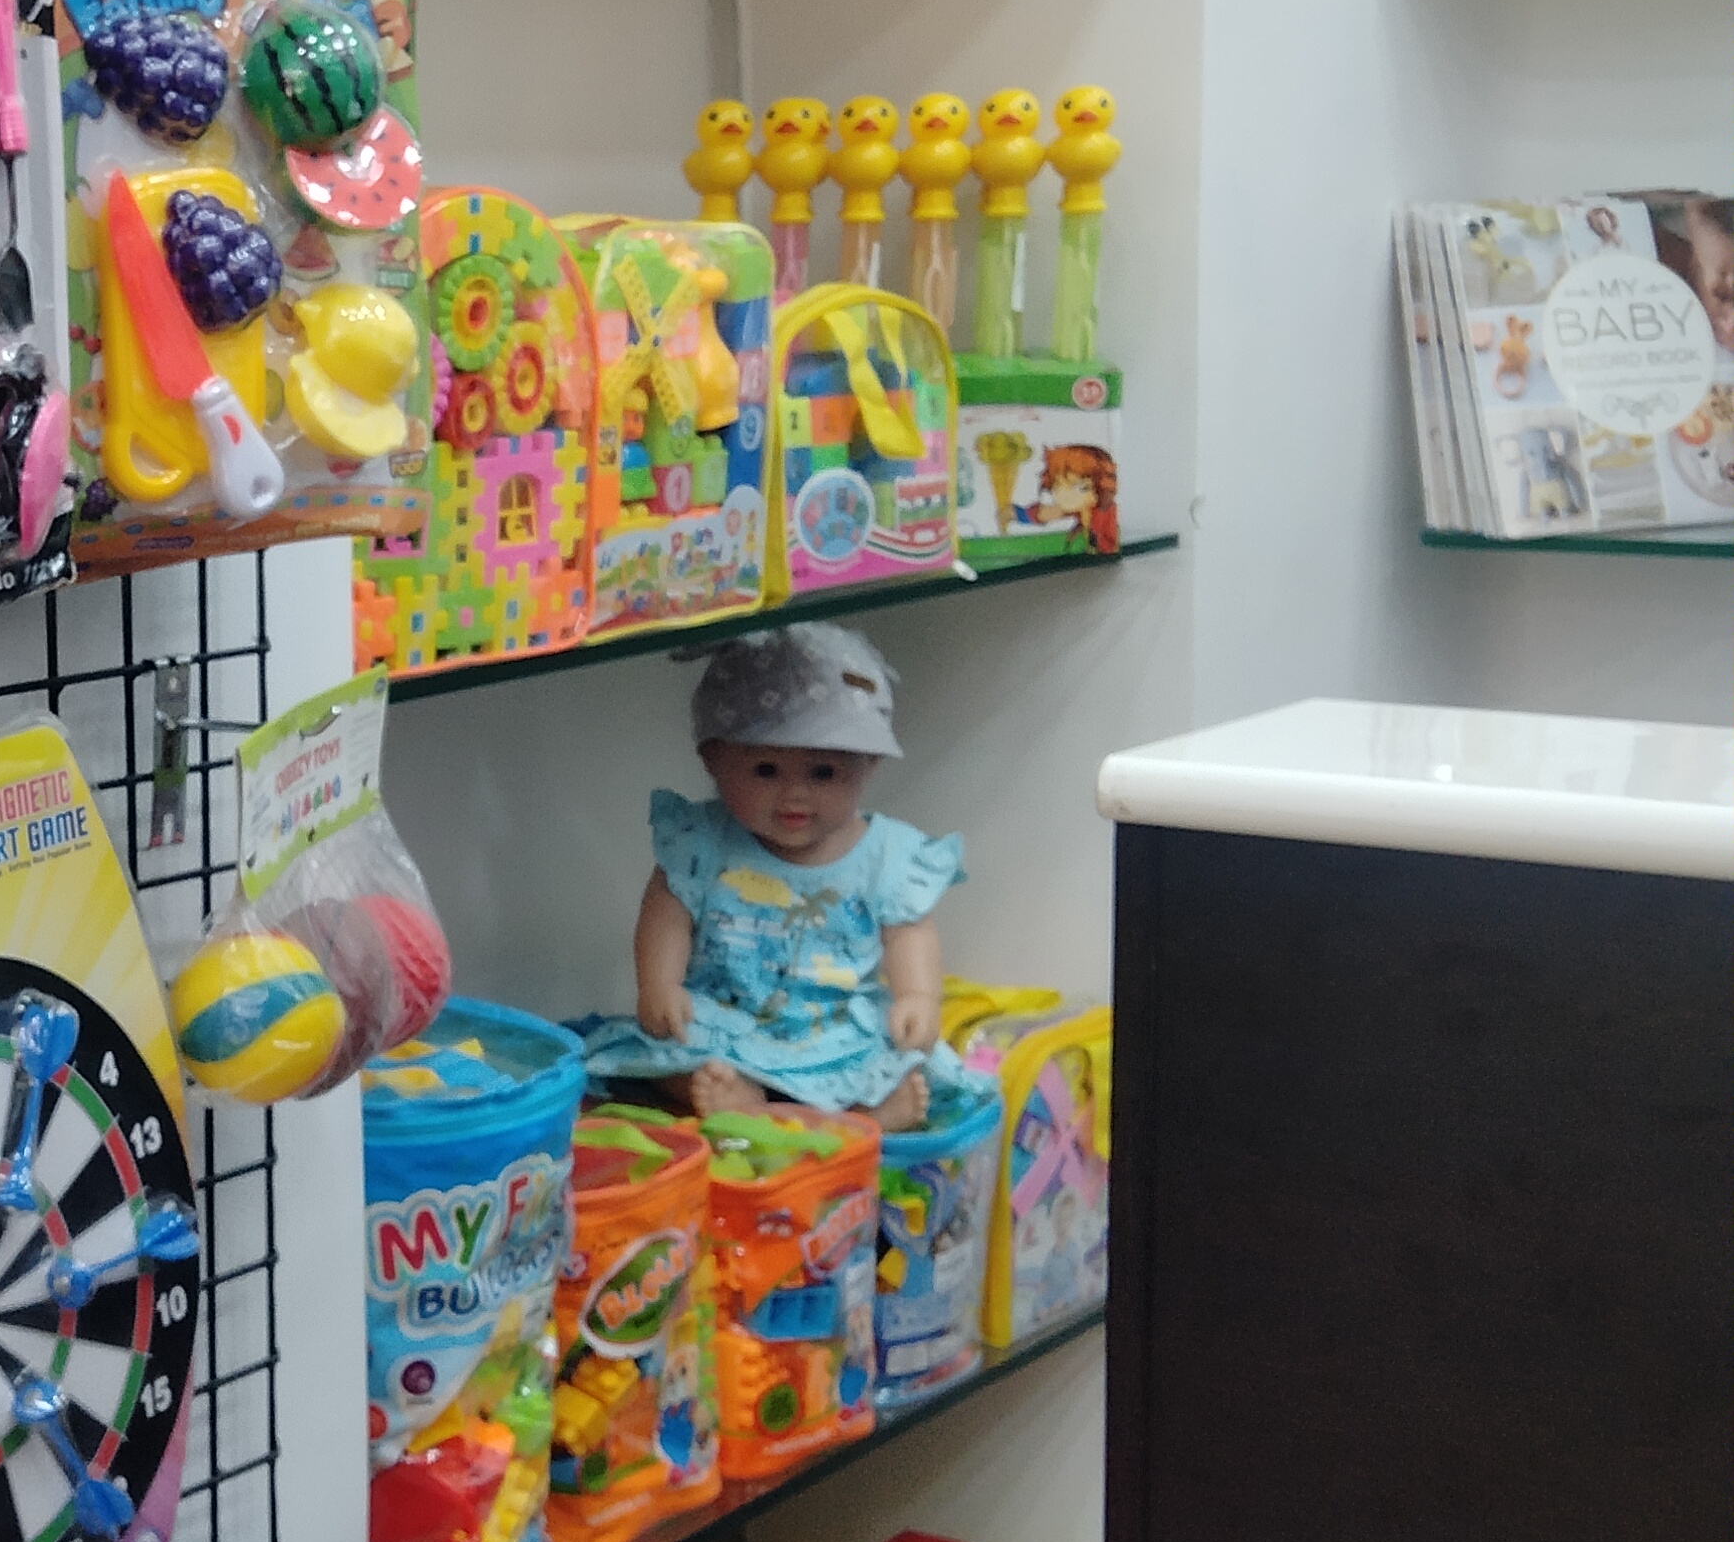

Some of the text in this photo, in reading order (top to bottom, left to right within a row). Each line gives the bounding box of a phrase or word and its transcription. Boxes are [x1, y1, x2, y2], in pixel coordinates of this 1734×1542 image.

[1599, 279, 1639, 299] MY
[1552, 300, 1696, 348] BABY
[26, 805, 89, 853] GAME
[99, 1051, 120, 1087] 4
[129, 1116, 163, 1158] 13
[378, 1201, 491, 1282] MY
[155, 1286, 188, 1327] 10
[140, 1379, 172, 1418] 15
